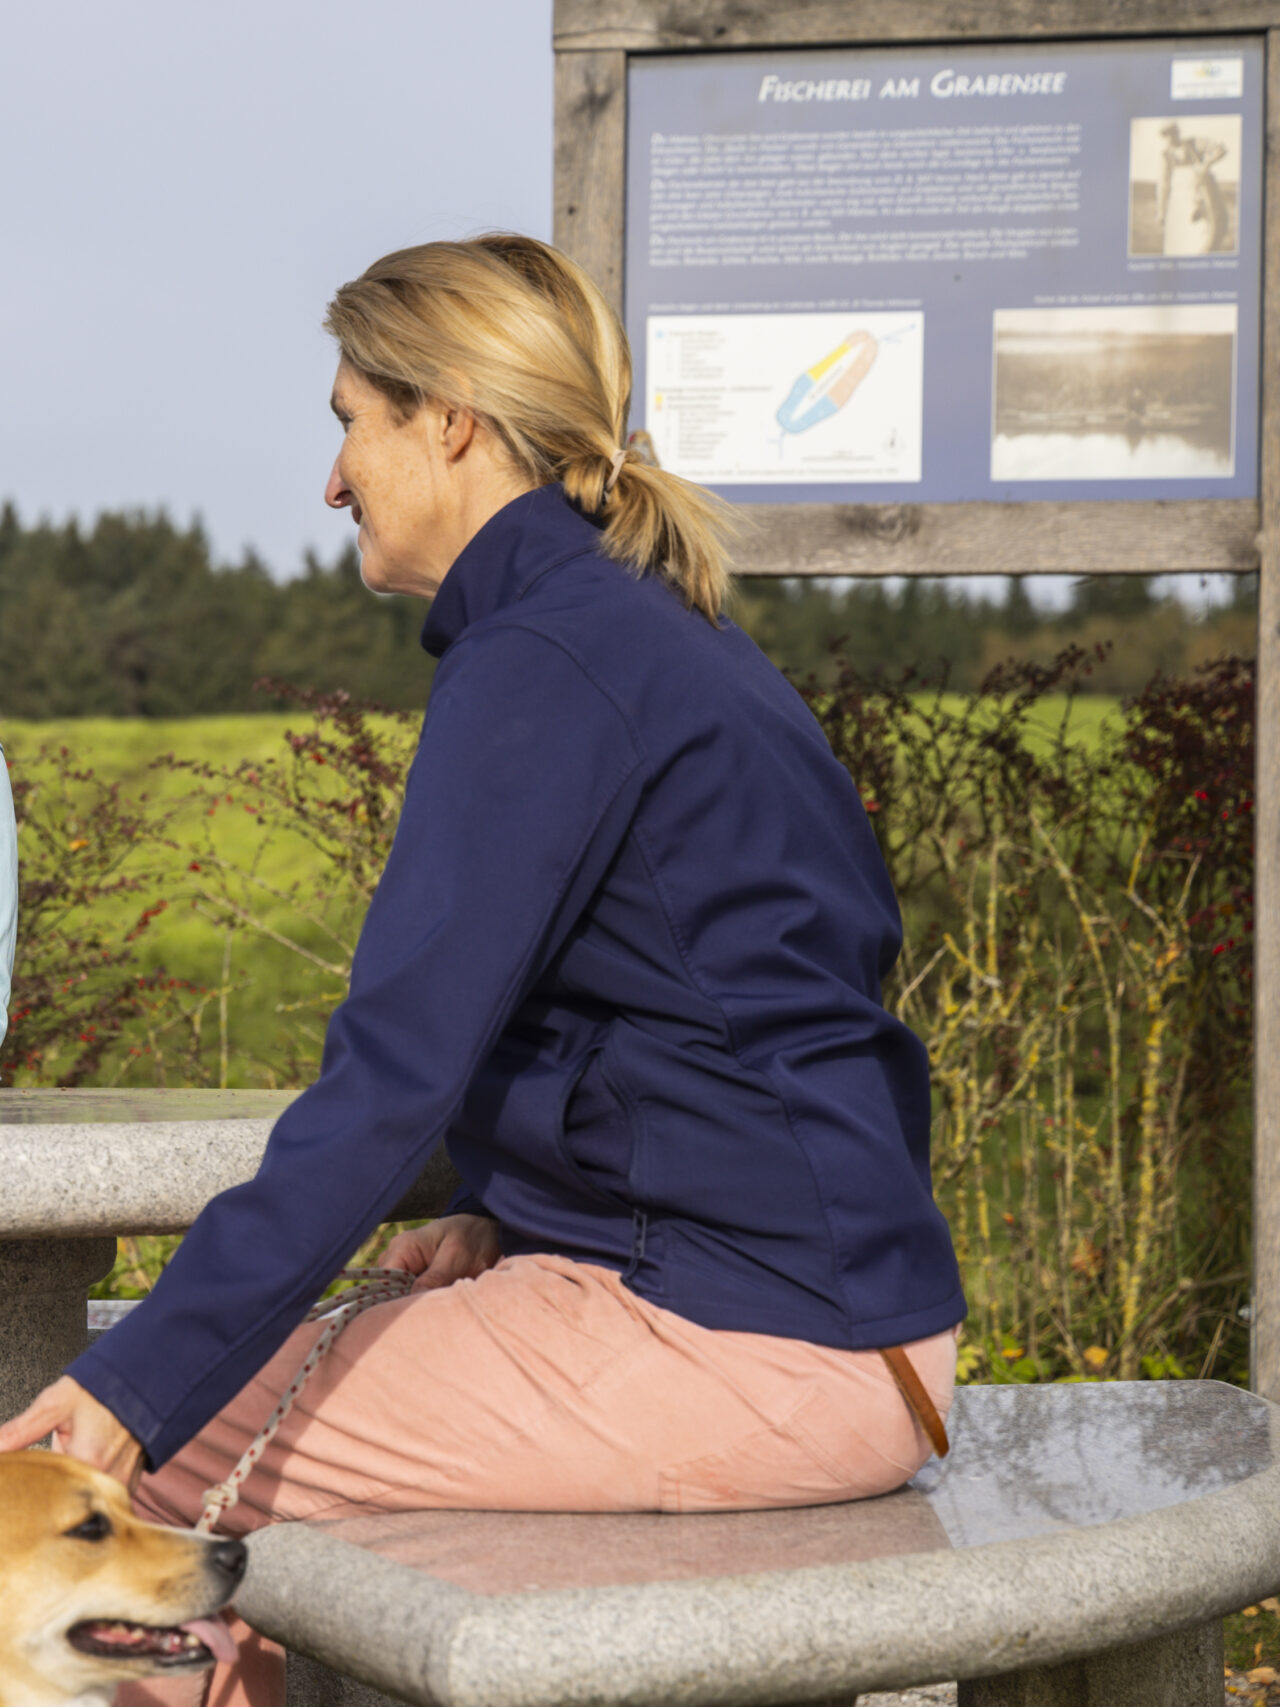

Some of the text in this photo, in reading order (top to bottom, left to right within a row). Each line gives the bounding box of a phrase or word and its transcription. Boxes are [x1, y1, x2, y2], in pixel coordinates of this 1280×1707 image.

[759, 69, 1067, 103] FISCHEREI AM GRABENSEE
